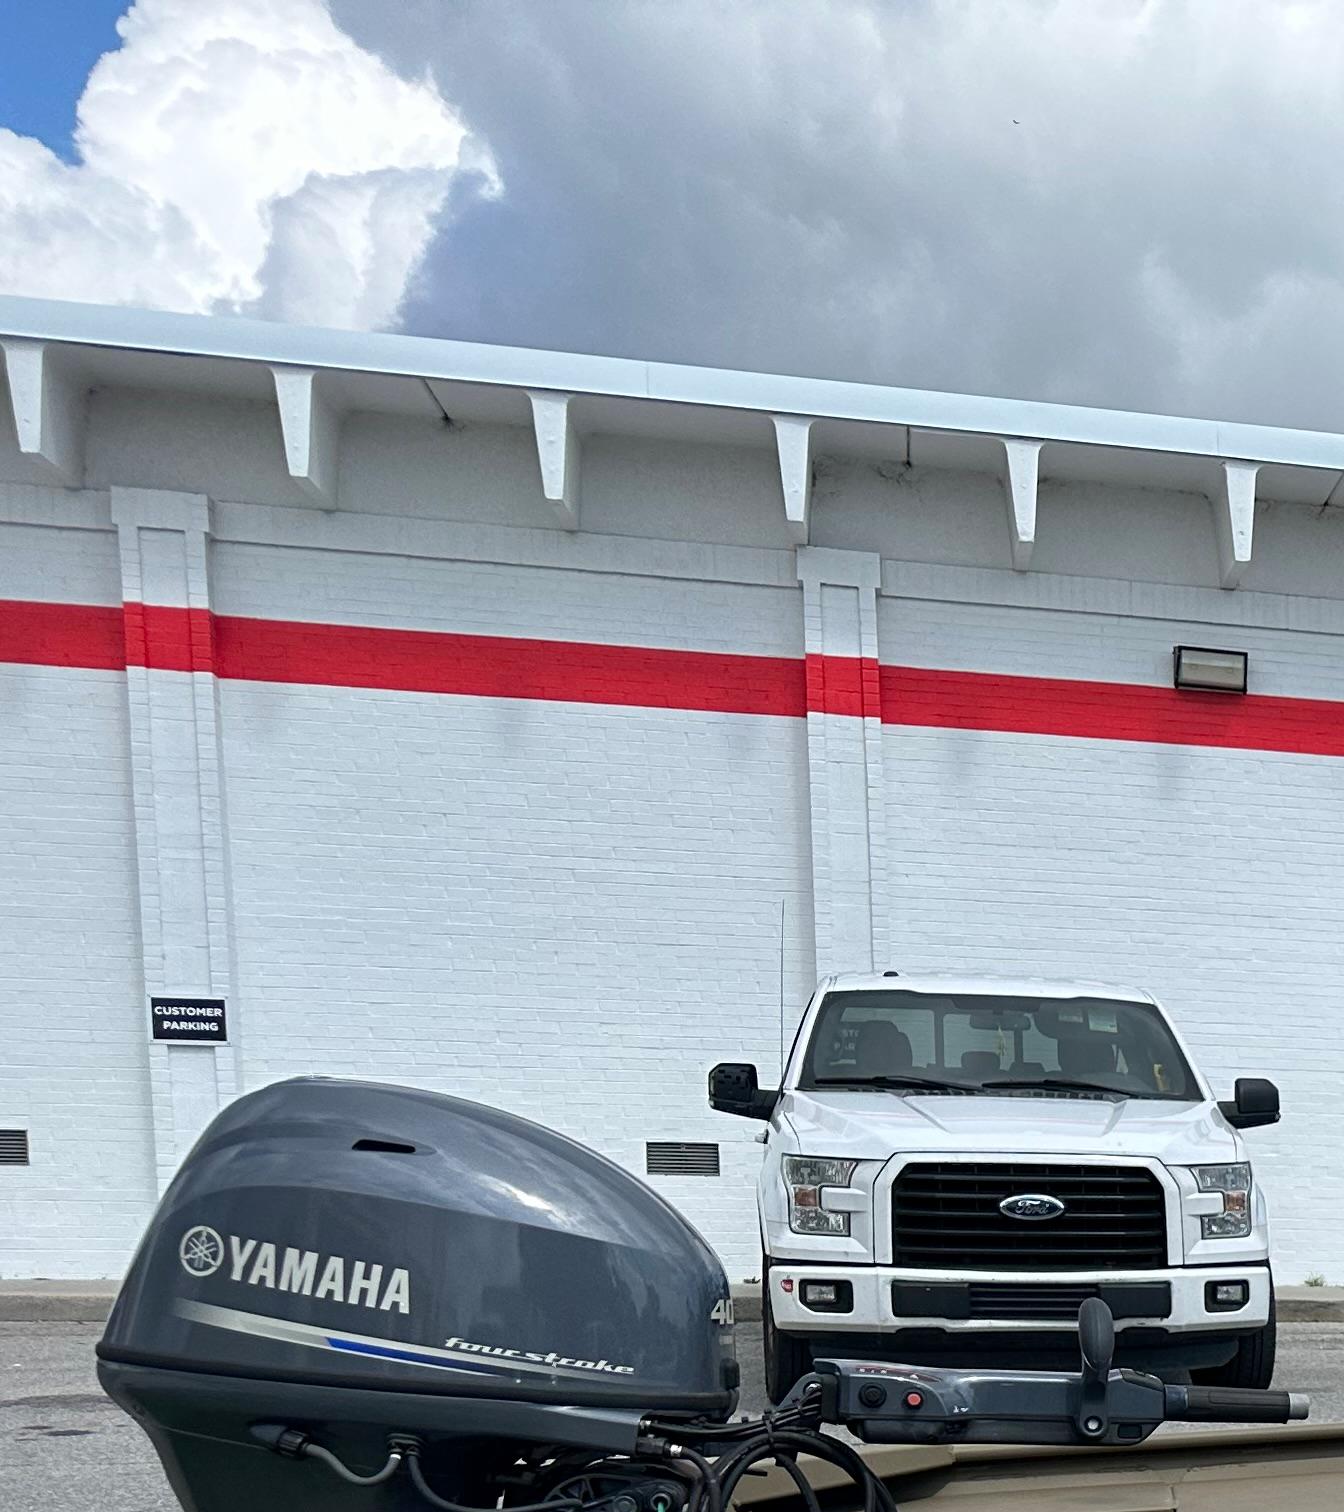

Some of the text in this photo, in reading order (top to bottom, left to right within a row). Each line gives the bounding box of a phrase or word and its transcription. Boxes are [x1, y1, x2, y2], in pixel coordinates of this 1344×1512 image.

[153, 1005, 223, 1018] CUSTOMER
[162, 1020, 219, 1032] PARKING
[229, 1235, 411, 1315] YAMAHA
[710, 1299, 735, 1325] 40
